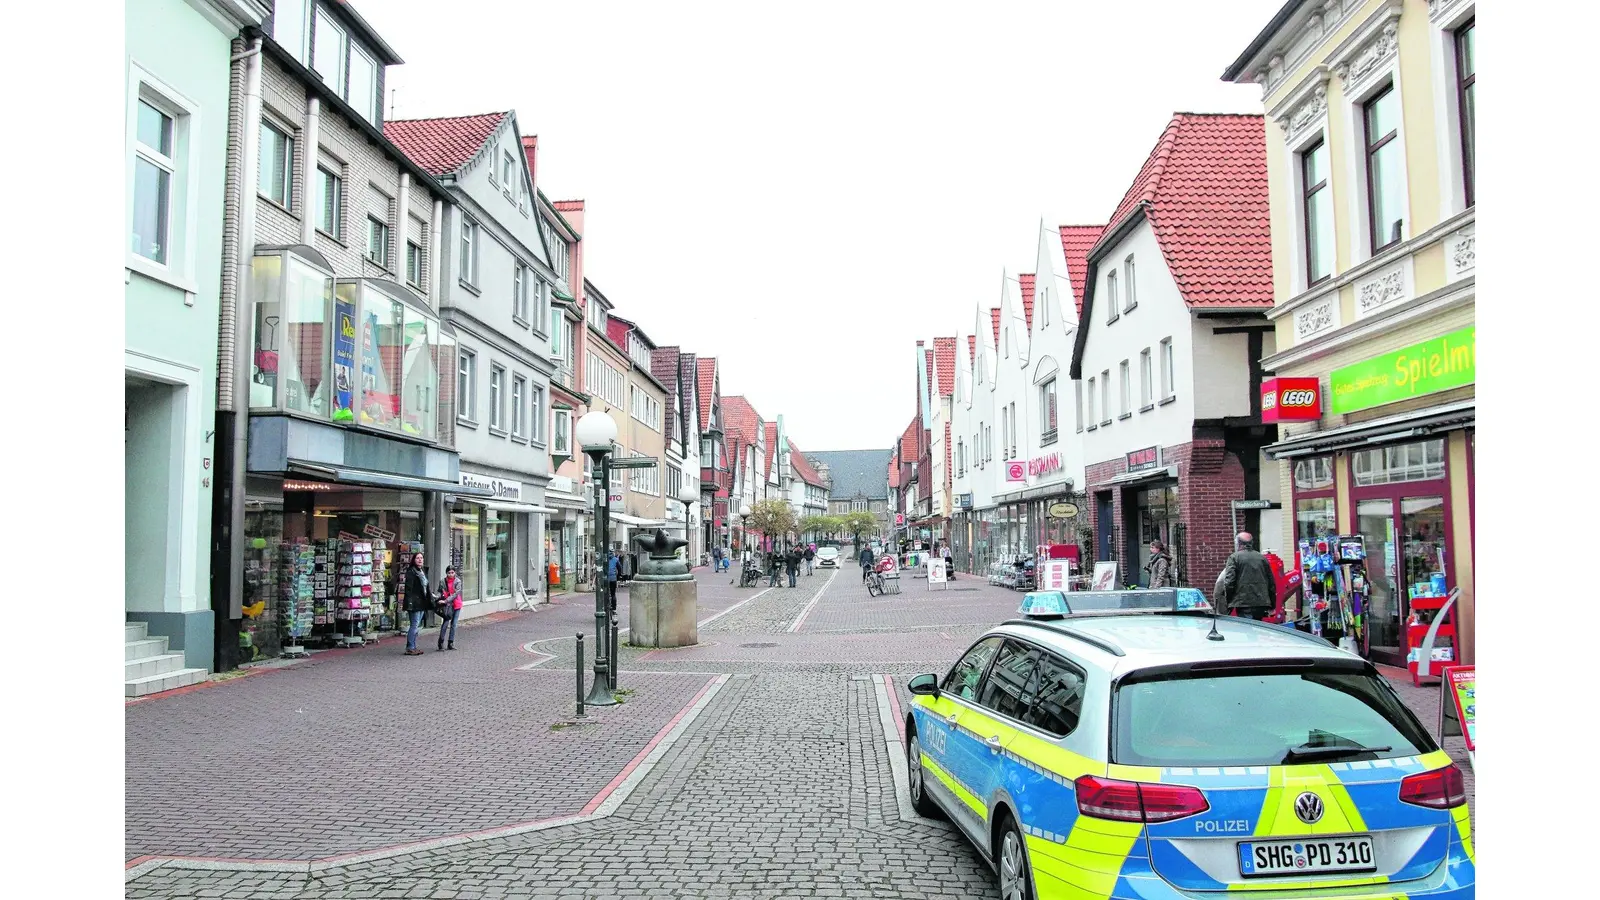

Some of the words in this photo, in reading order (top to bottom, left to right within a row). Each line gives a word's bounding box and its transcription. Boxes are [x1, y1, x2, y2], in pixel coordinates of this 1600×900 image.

[1281, 390, 1315, 406] LEGO
[926, 719, 947, 755] POLIZEI
[1195, 820, 1249, 832] POLIZEI
[1255, 845, 1294, 869] SHG
[1306, 843, 1332, 866] PD
[1336, 841, 1371, 865] 310
